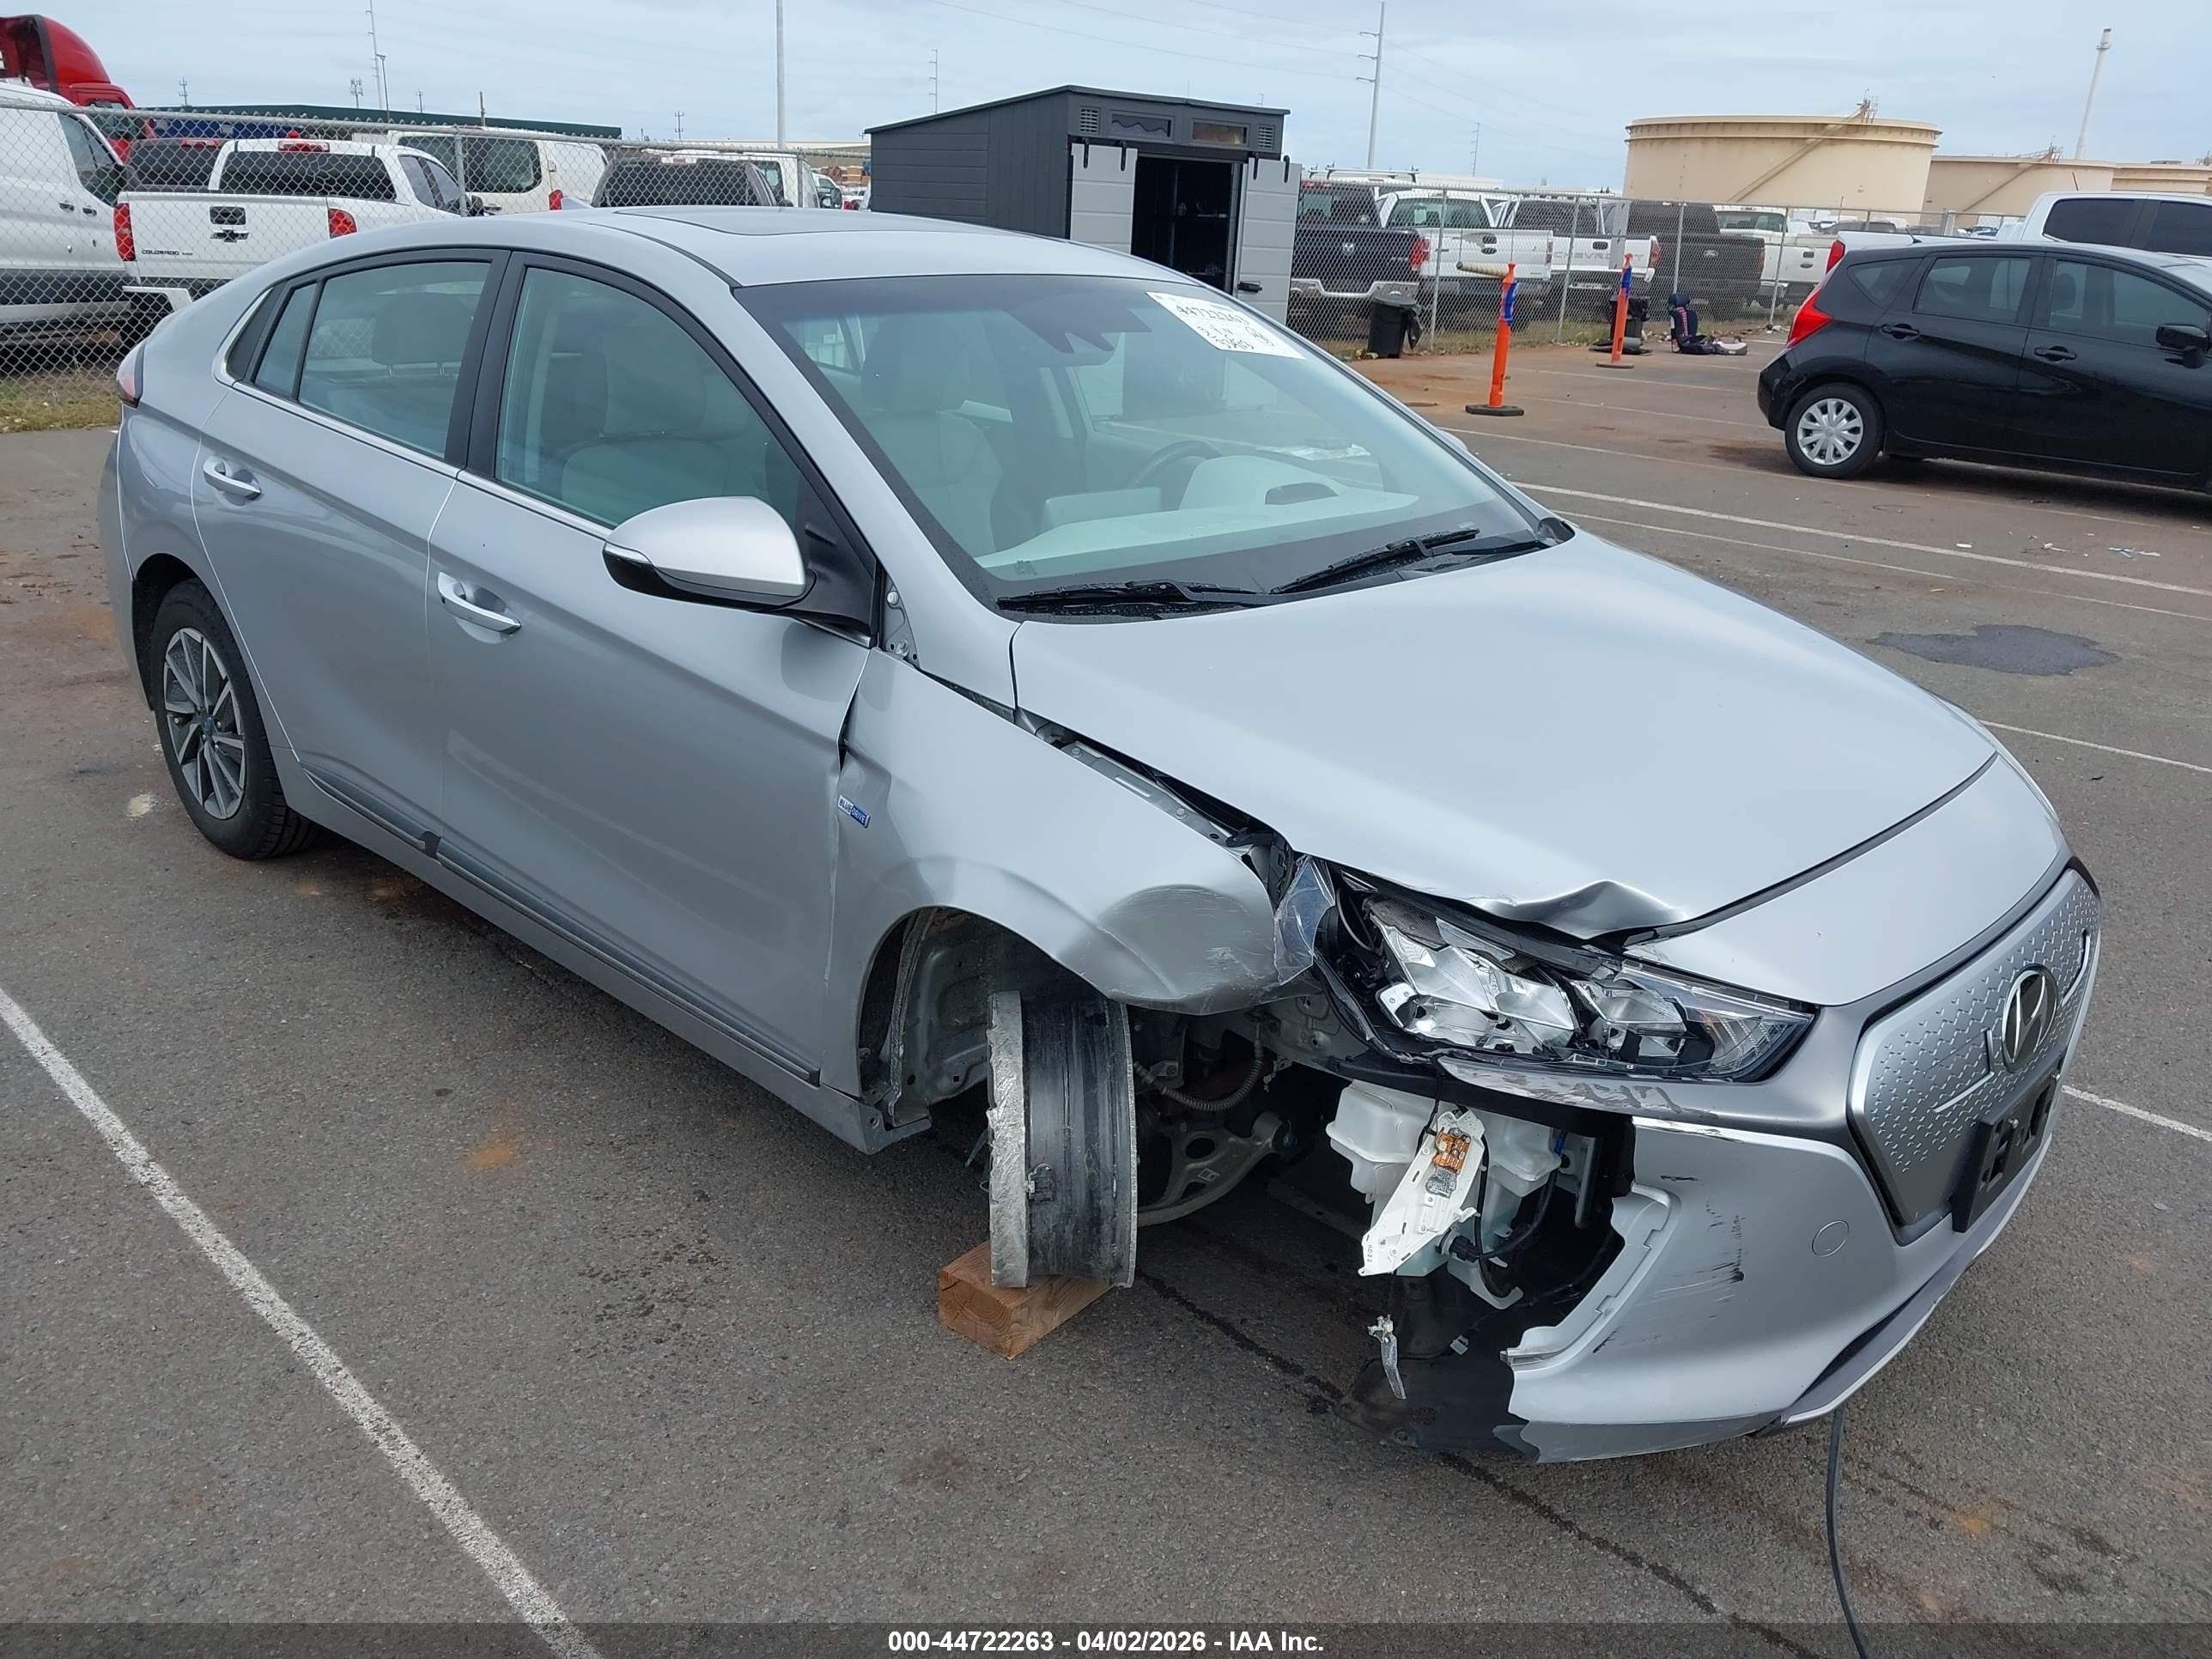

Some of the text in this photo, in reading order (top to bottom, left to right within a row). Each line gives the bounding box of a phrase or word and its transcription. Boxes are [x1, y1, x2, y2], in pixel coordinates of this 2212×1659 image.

[1176, 304, 1250, 325] 44722263
[839, 798, 866, 823] BLUE DRIVE
